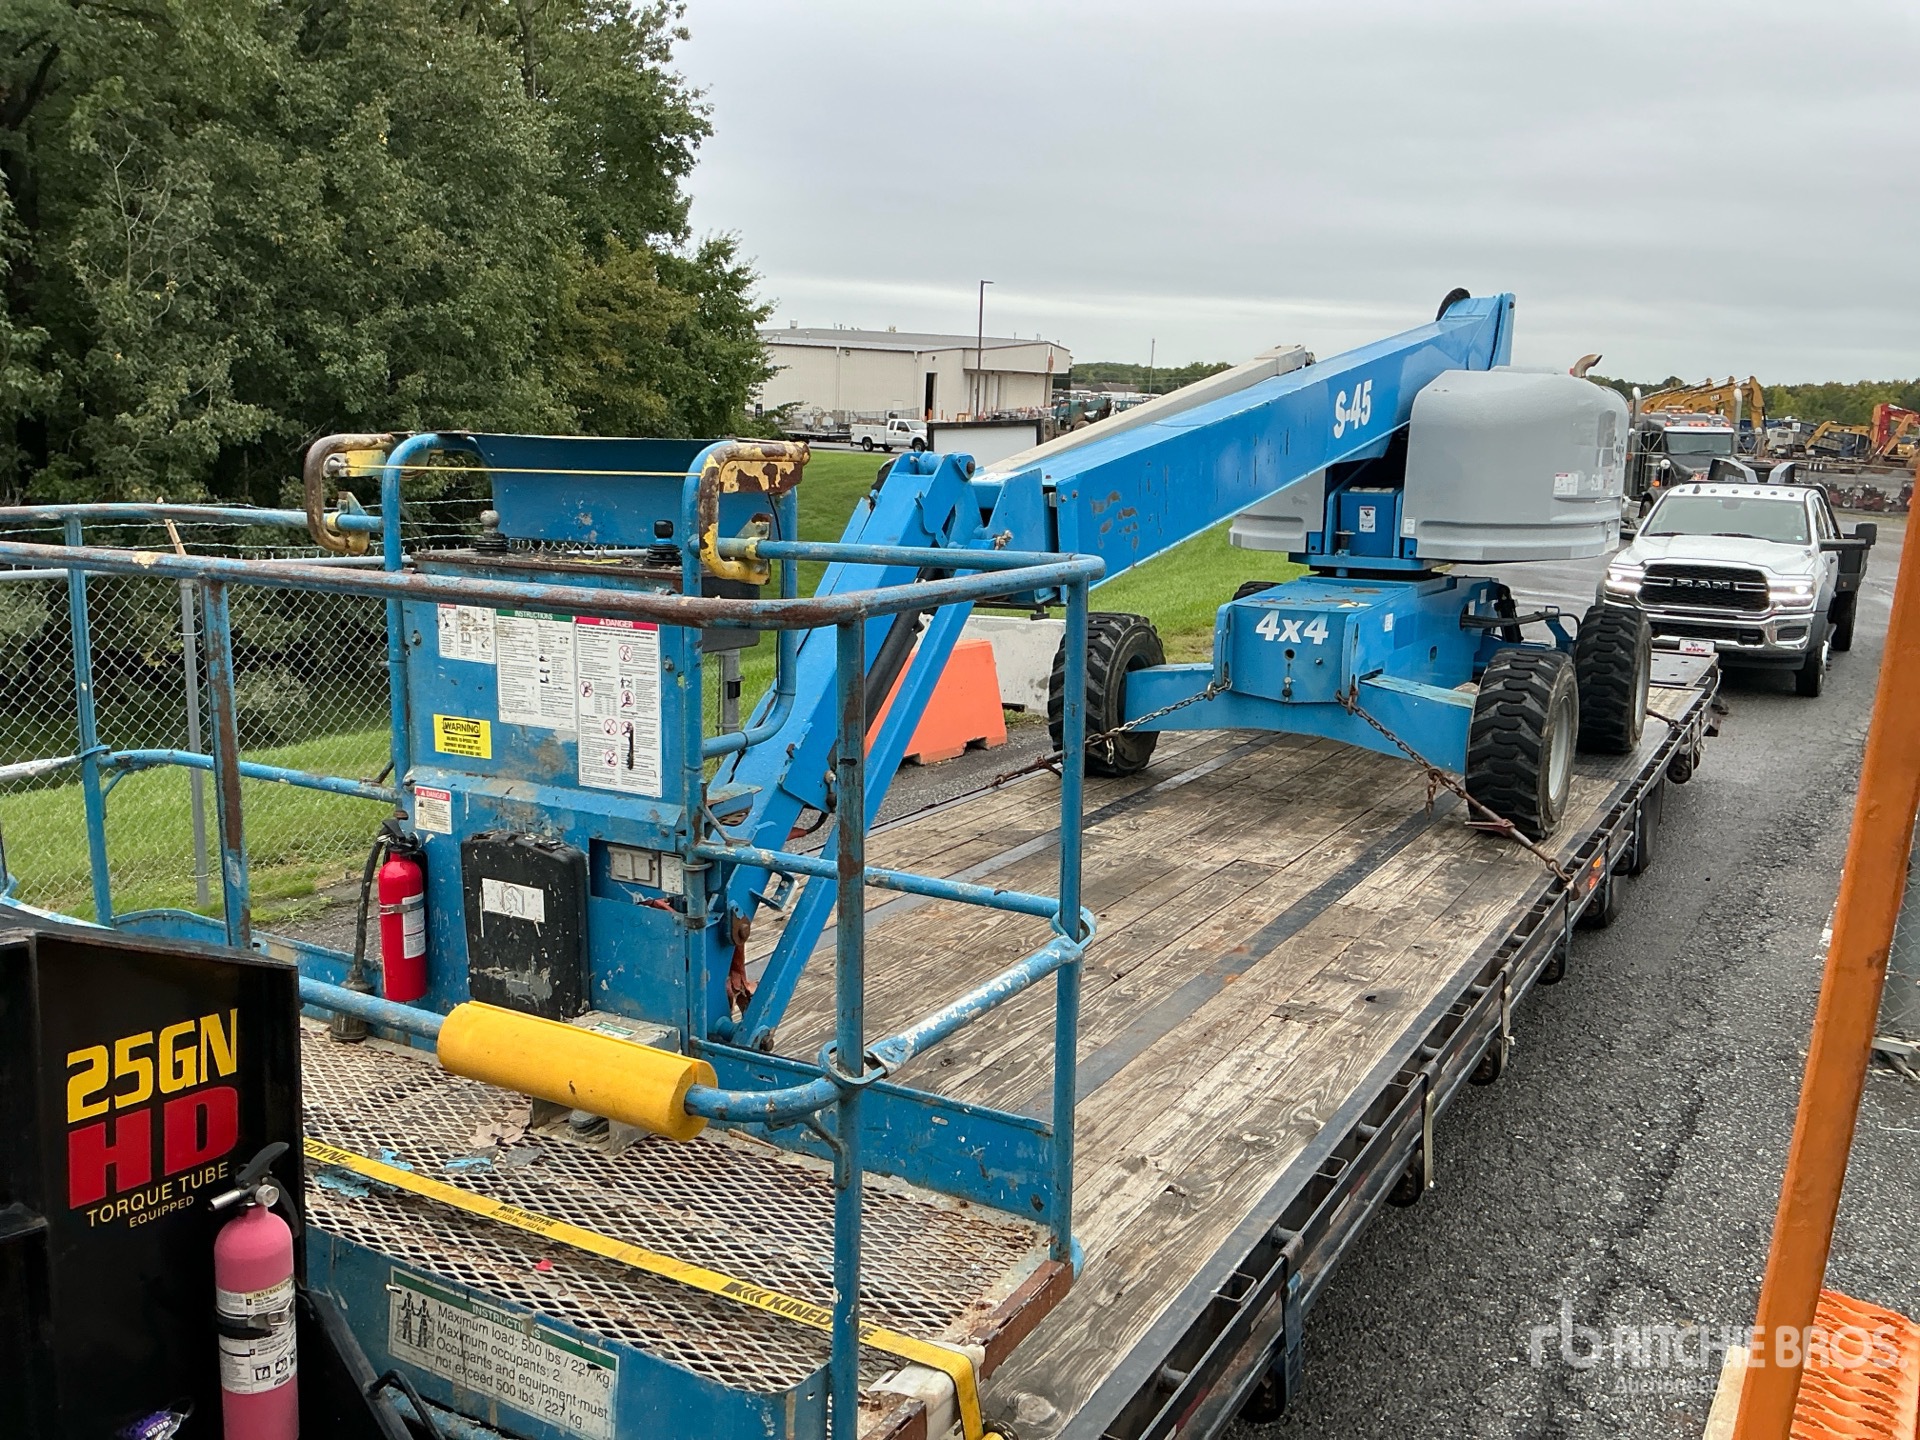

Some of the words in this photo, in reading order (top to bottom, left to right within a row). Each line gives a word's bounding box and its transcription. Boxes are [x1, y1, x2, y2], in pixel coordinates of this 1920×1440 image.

[1333, 379, 1373, 439] S-45
[1677, 579, 1730, 590] RAM
[514, 610, 553, 620] INSTRUCTIONS
[605, 619, 634, 629] DANGER
[1255, 610, 1329, 645] 4x4
[444, 722, 479, 734] WARNING
[67, 1008, 238, 1124] 25GN
[68, 1086, 239, 1210] HD
[87, 1181, 173, 1228] TORQUE
[179, 1161, 230, 1194] TUBE
[129, 1195, 195, 1228] EQUIPPED
[438, 1305, 489, 1335] Maximum
[491, 1326, 518, 1348] load:
[521, 1339, 542, 1357] 500
[545, 1348, 561, 1365] lbs
[472, 1304, 541, 1339] INSTRUCTIS
[436, 1337, 493, 1370] Occupants
[495, 1363, 516, 1380] and
[518, 1373, 577, 1406] equipment
[579, 1399, 608, 1420] must
[437, 1321, 488, 1351] Maximum
[491, 1345, 550, 1377] occupants:
[552, 1369, 563, 1384] 2.
[435, 1355, 452, 1370] not
[455, 1363, 493, 1387] exceed
[496, 1379, 516, 1397] 500
[519, 1388, 535, 1405] lbs
[545, 1400, 566, 1417] 227
[569, 1410, 585, 1429] kg.
